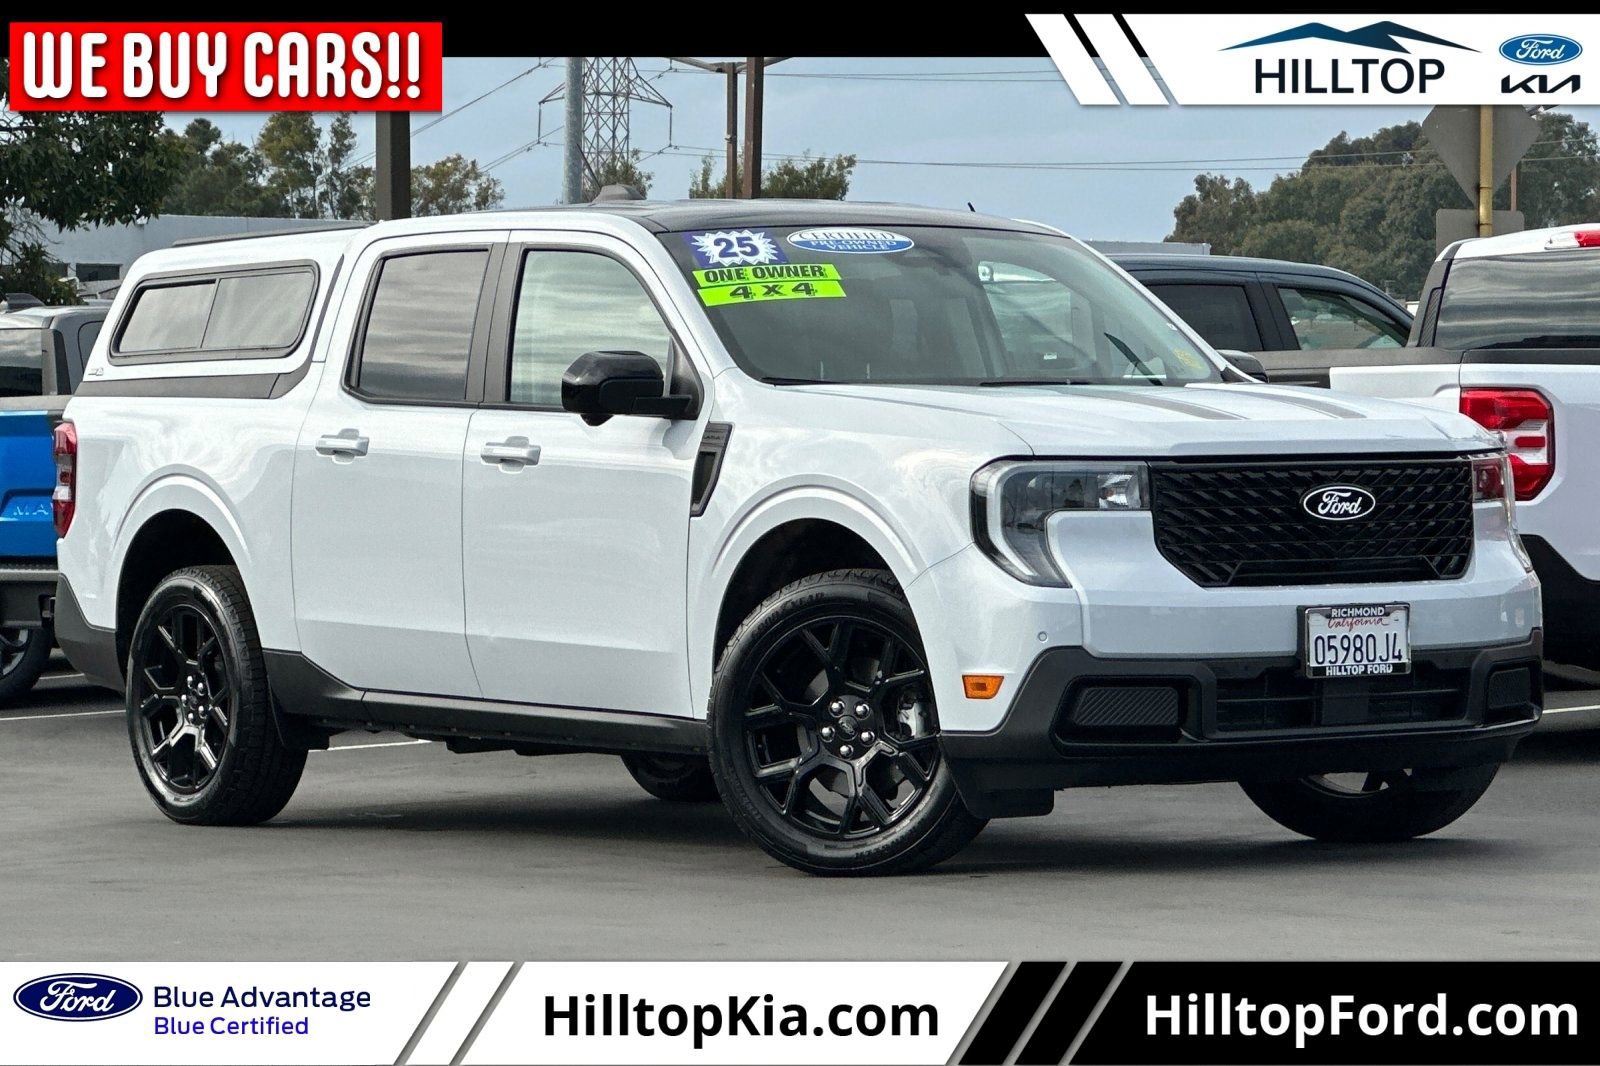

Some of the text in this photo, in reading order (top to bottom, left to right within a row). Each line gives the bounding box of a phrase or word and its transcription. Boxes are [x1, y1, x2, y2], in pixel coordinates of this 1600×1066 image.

[799, 231, 896, 240] CERTIFIED
[713, 236, 760, 259] 25
[704, 264, 824, 283] ONE OWNER
[1317, 491, 1362, 514] Ford
[1331, 607, 1385, 618] RICHMOND
[1328, 617, 1389, 632] California
[1314, 632, 1402, 665] 05980J4
[1326, 664, 1393, 676] HILLTOP FORD
